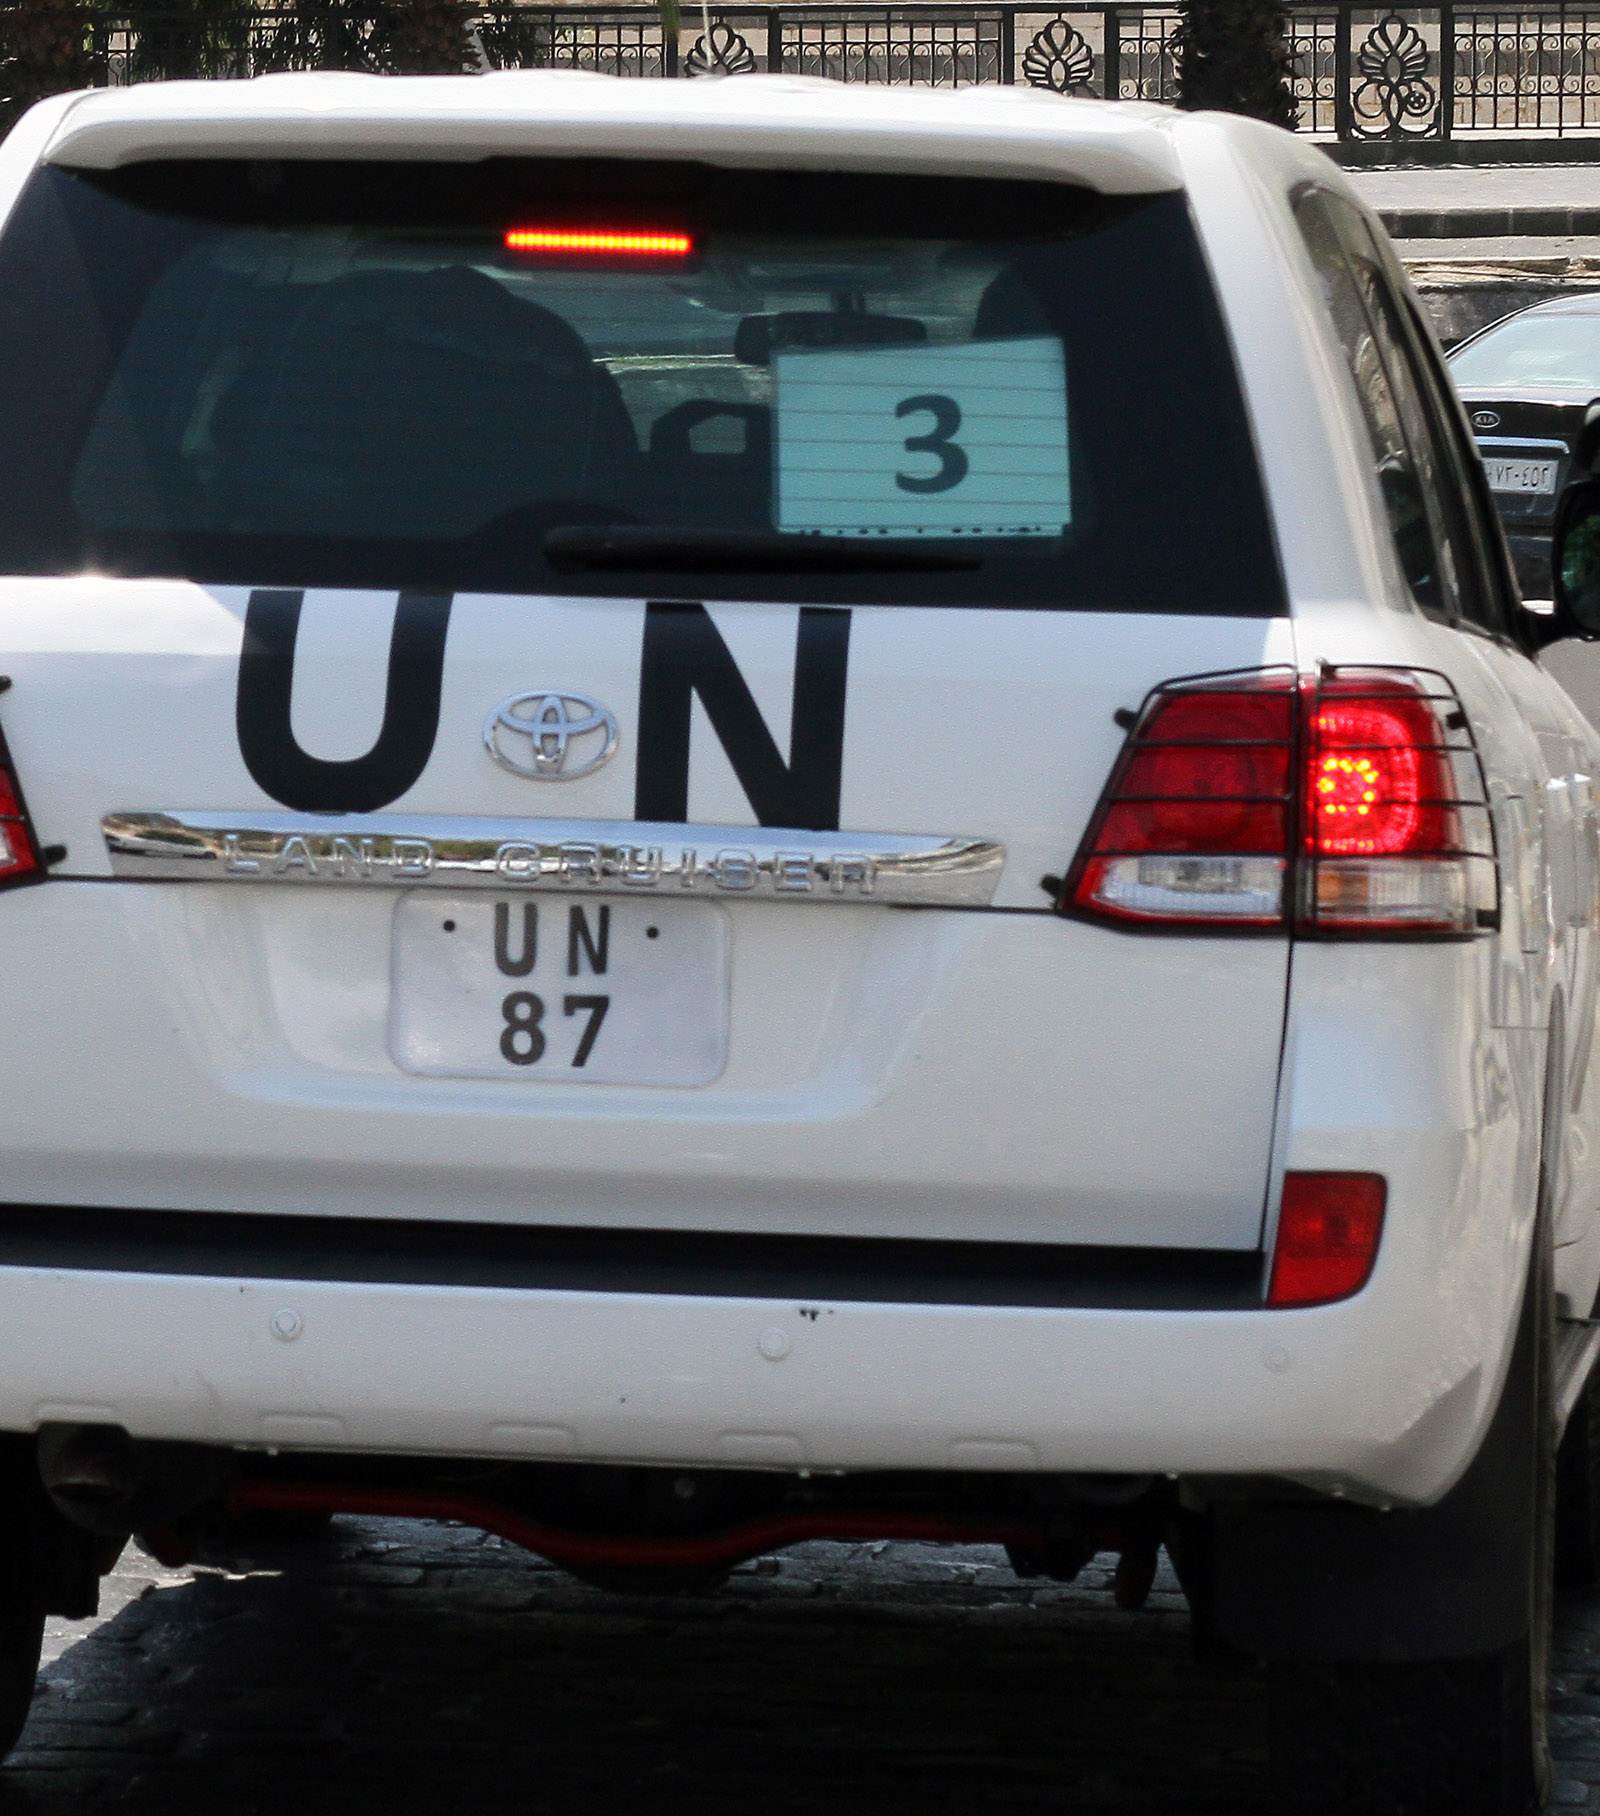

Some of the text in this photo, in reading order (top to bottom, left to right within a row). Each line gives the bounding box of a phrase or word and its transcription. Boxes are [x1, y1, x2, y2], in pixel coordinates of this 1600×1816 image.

[895, 394, 969, 494] 3
[223, 833, 878, 894] LAND CRUISER
[500, 991, 610, 1067] 87
